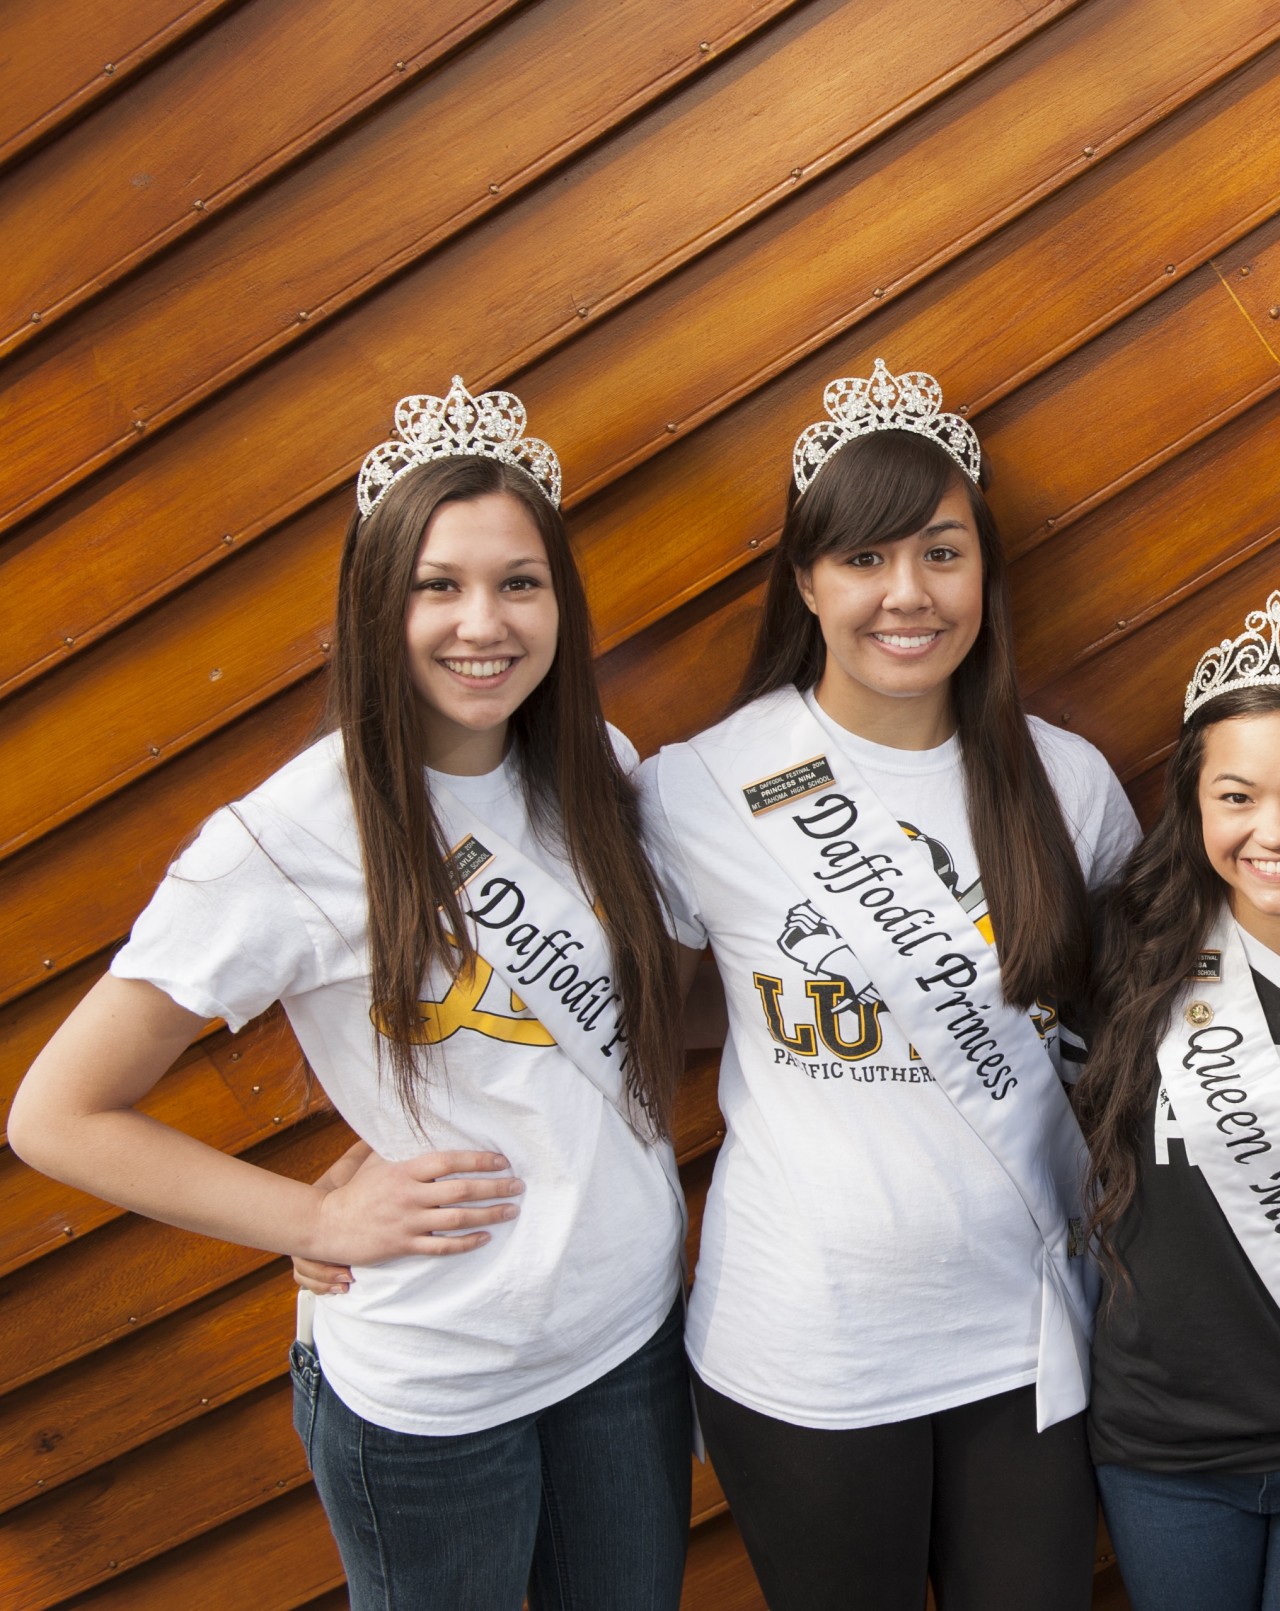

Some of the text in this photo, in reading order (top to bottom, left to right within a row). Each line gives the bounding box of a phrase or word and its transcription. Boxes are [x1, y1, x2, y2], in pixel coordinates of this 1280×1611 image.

[760, 777, 785, 789] DAFFODIL
[786, 767, 810, 779] FESTIVAL
[812, 760, 825, 769] 2014
[761, 772, 816, 797] PRINCESS NINA
[764, 792, 788, 805] TAHOMA
[790, 785, 805, 794] HIGH
[808, 776, 831, 788] SCHOOL
[470, 852, 490, 870] SCHOOL
[465, 877, 619, 1032] Daffodil
[792, 793, 1018, 1101] Daffodil Princess
[774, 1047, 937, 1083] PAIFIC LUTHER
[1182, 1026, 1272, 1165] Queen
